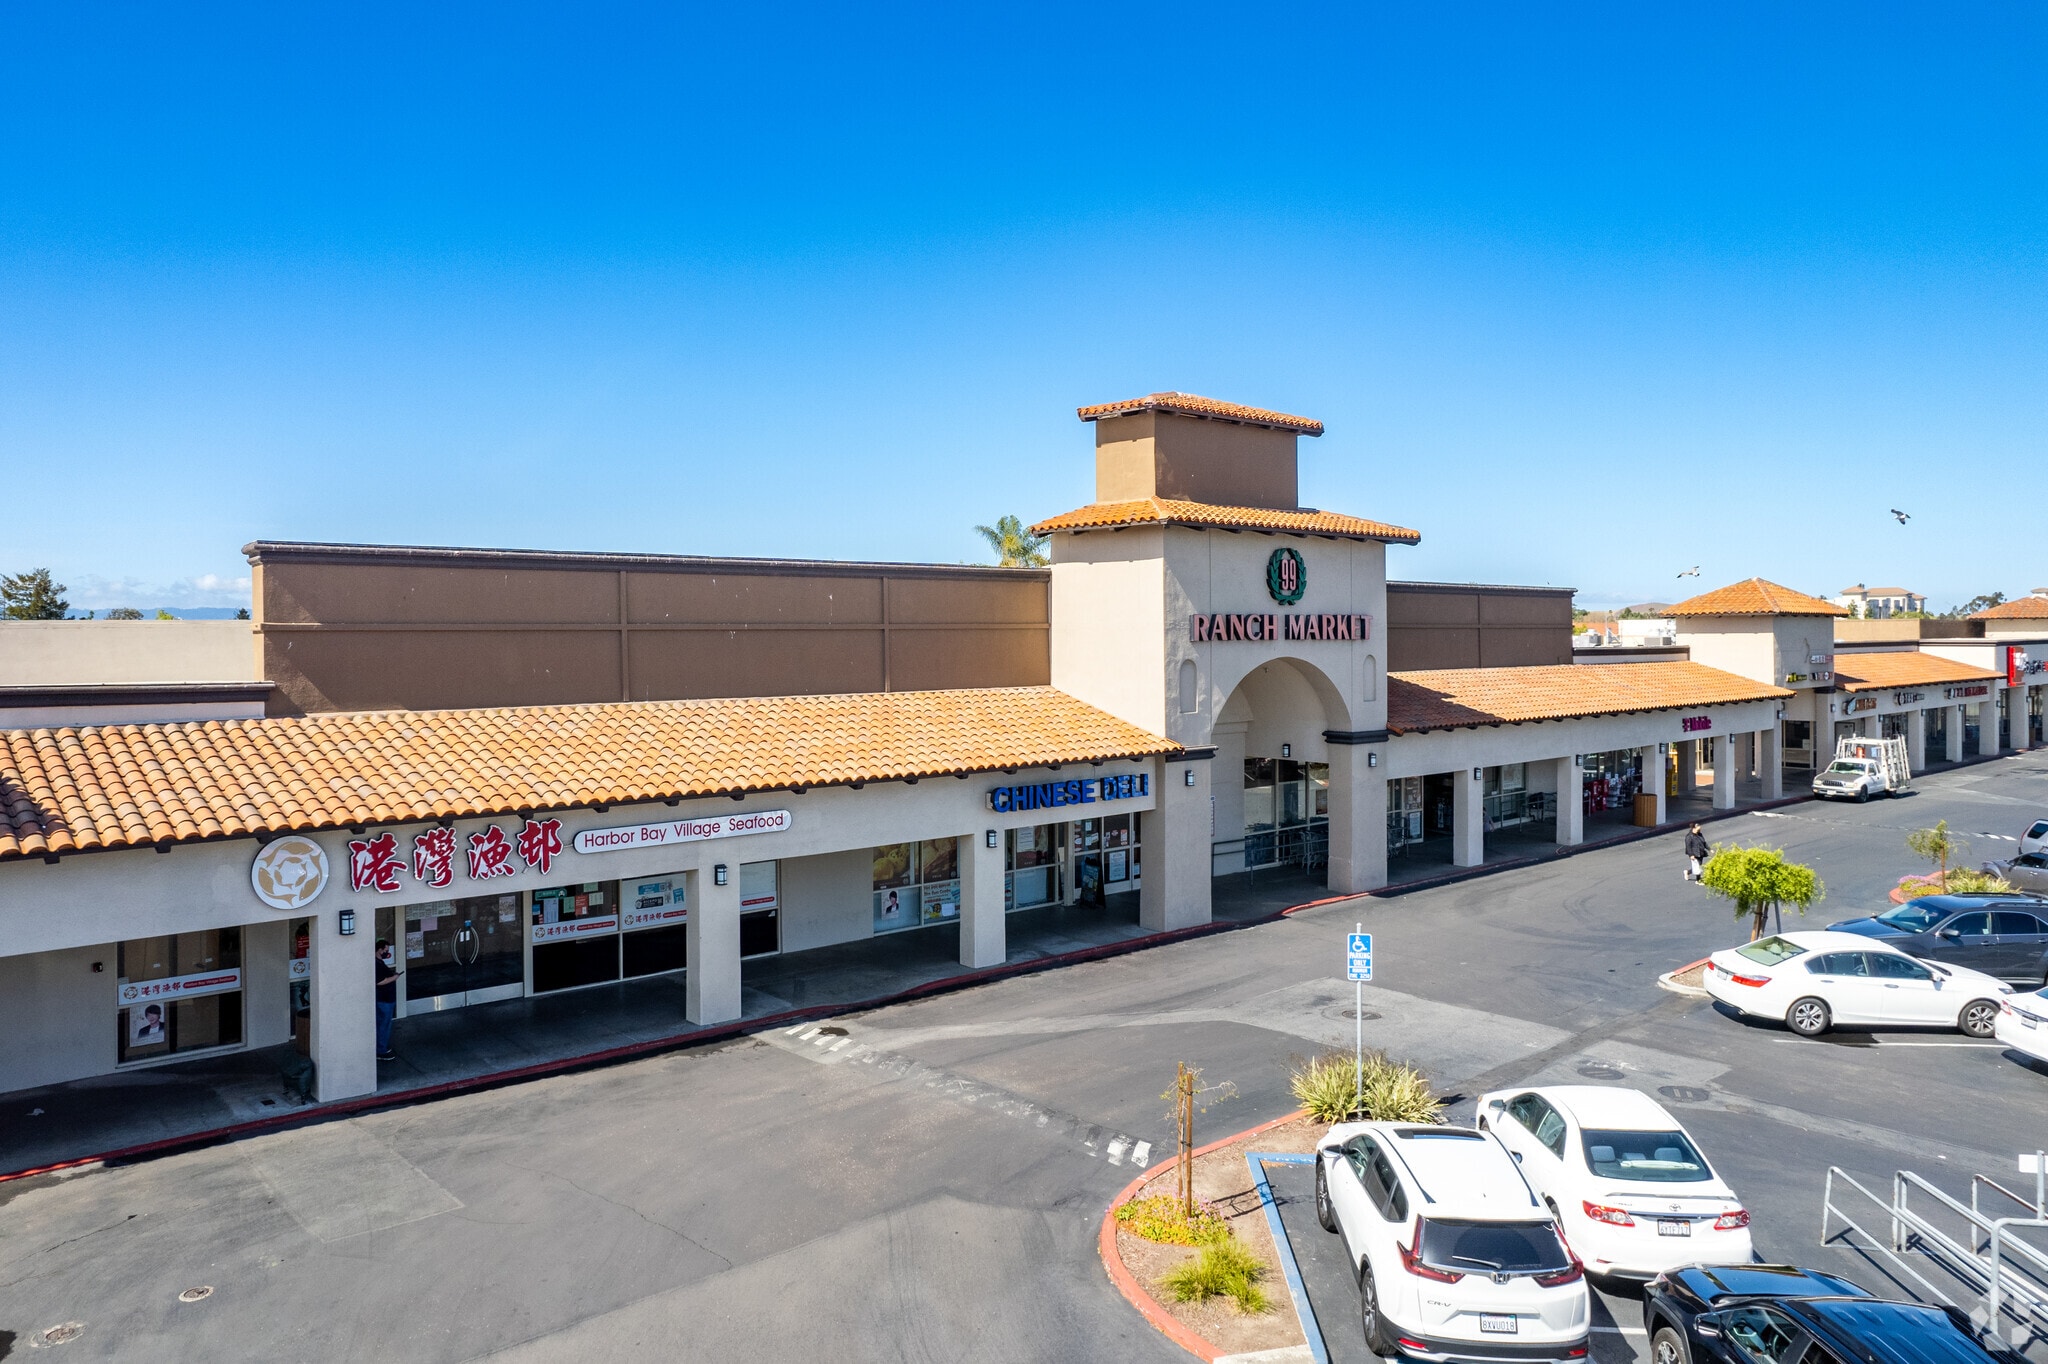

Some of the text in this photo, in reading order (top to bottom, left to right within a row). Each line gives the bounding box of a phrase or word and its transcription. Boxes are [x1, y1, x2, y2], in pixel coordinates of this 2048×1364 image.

[1281, 559, 1297, 590] 99
[1191, 613, 1373, 642] RANCH MARKET
[992, 773, 1149, 813] CHINESE DELI
[584, 813, 784, 848] Harbor Bay Village Seafood
[348, 818, 564, 893] 港灣漁邨
[1427, 1299, 1452, 1308] CR-V
[1482, 1320, 1515, 1331] 8XVU018
